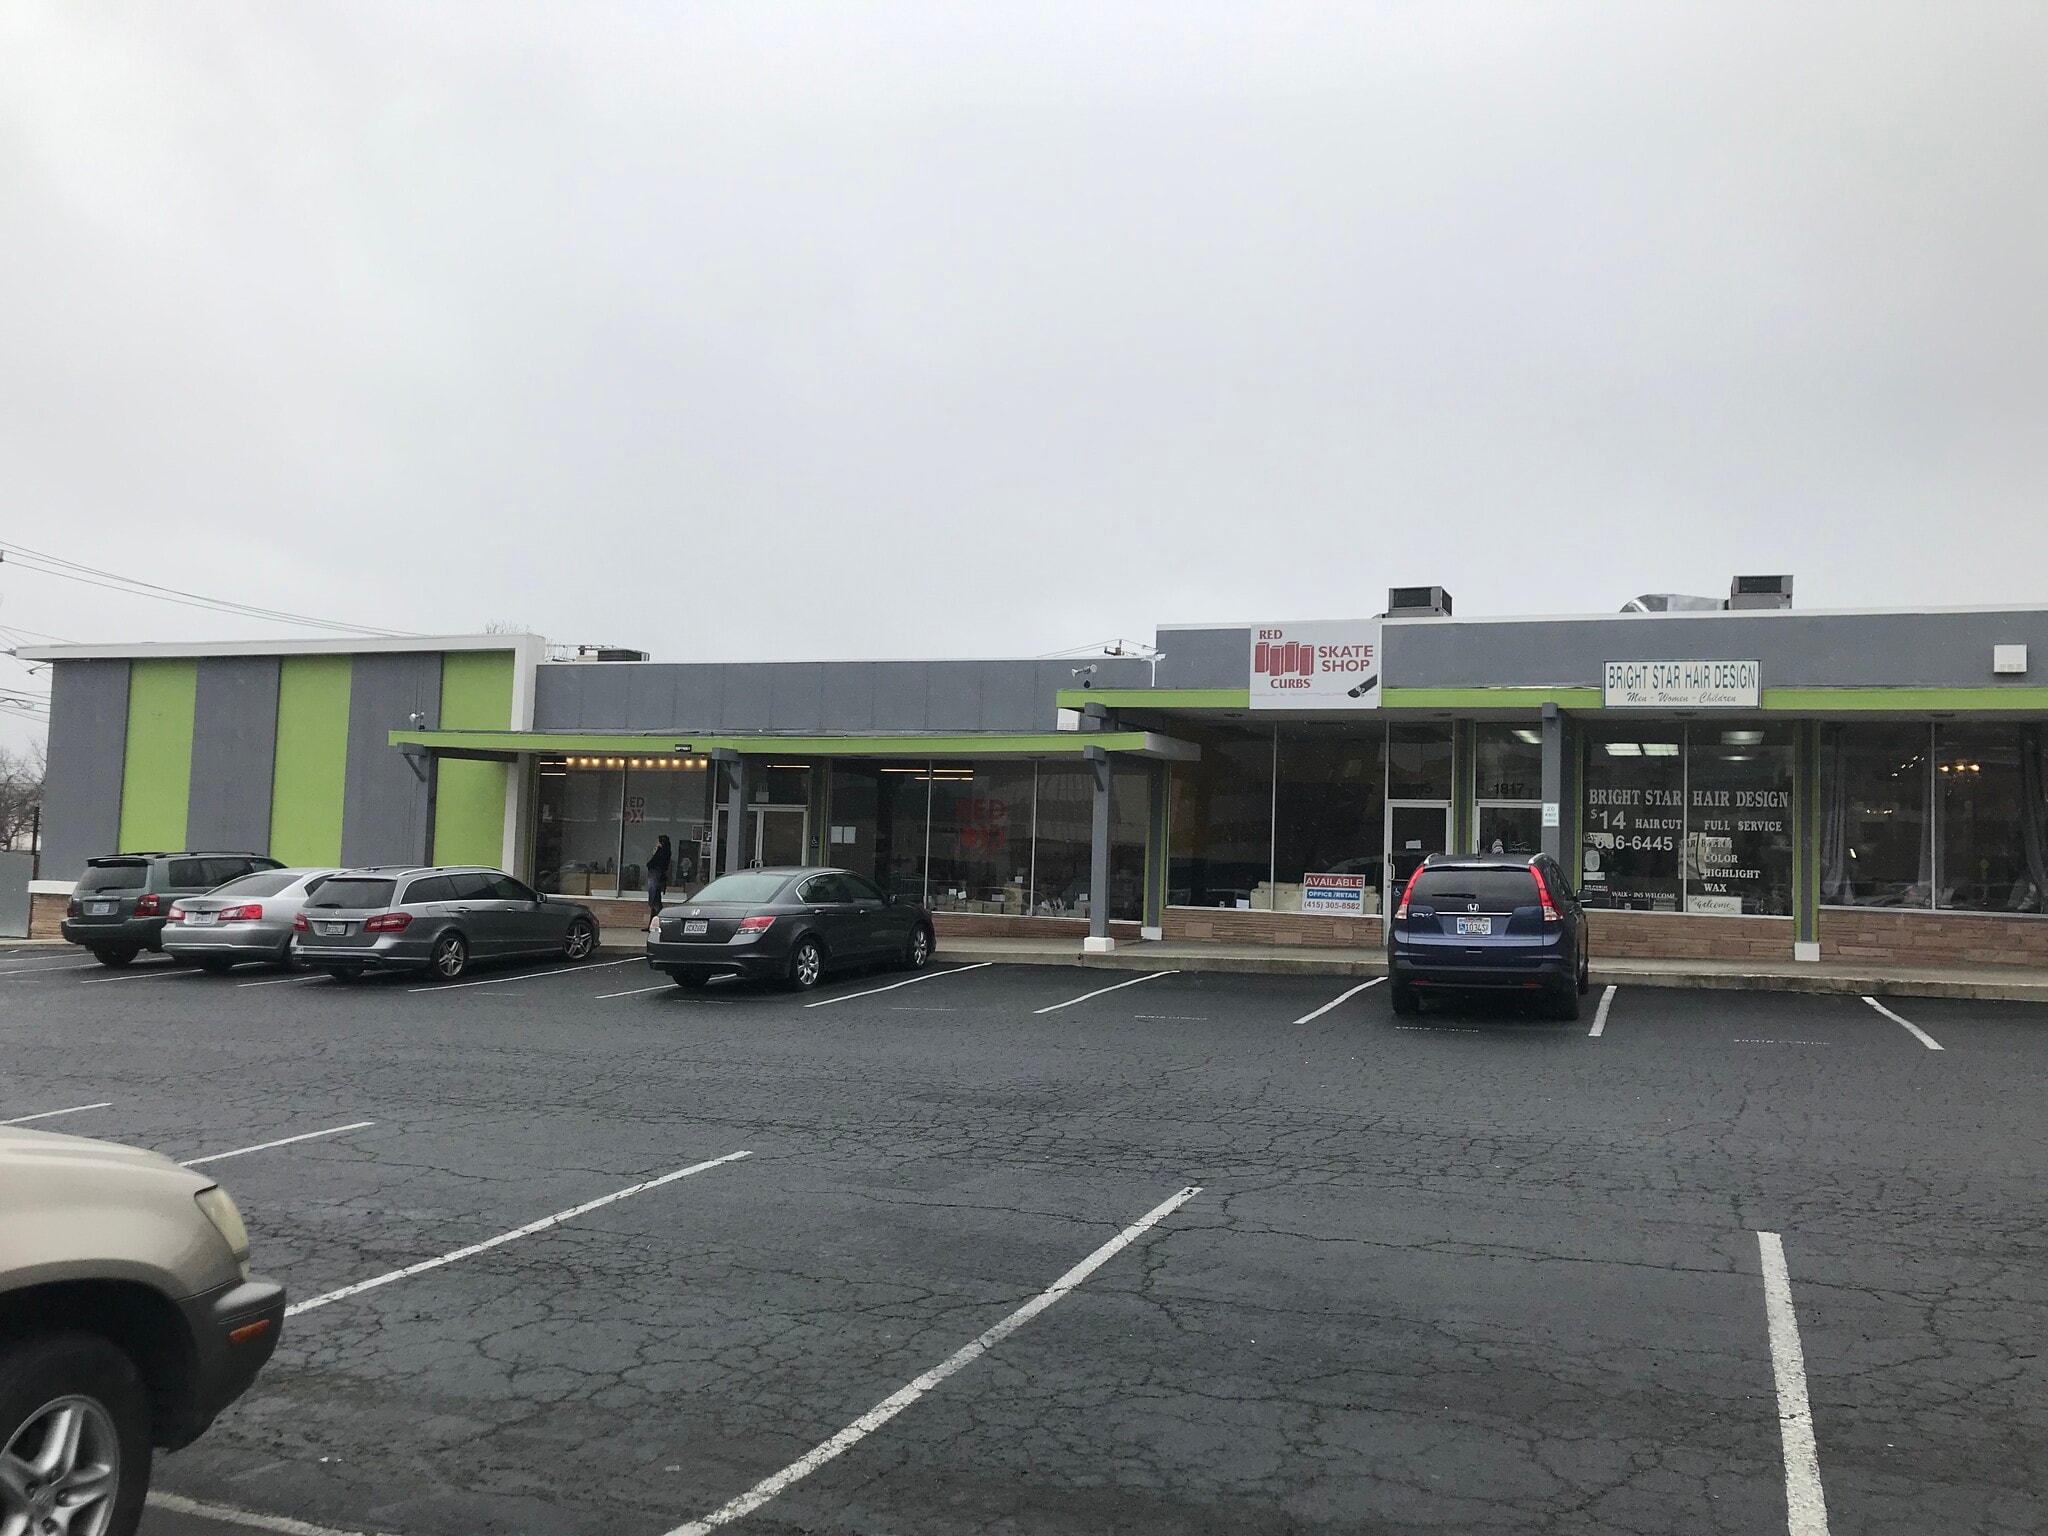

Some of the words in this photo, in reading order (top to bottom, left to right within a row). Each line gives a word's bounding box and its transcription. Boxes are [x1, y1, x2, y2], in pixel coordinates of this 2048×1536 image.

[1259, 630, 1283, 640] RED
[1318, 645, 1374, 658] SKATE
[1321, 659, 1370, 672] SHOP
[1609, 665, 1648, 689] BRIGHT
[1652, 665, 1681, 689] STAR
[1685, 665, 1711, 689] HAIR
[1714, 664, 1755, 689] DESIGN
[1270, 678, 1311, 689] CURBS
[1627, 692, 1647, 702] Men
[1658, 692, 1688, 702] Women
[1699, 691, 1737, 704] Children
[1589, 789, 1640, 805] BRIGHT
[1645, 789, 1682, 806] STAR
[1692, 790, 1730, 806] HAIR
[1735, 790, 1789, 808] DESIGN
[1704, 820, 1730, 831] FULL
[1737, 820, 1782, 832] SERVICE
[1704, 854, 1738, 863] COLOR
[1704, 869, 1760, 879] HIGHLIGHT
[1305, 877, 1362, 887] AVAILABLE
[1704, 883, 1727, 893] WAX
[1308, 890, 1332, 898] OFFICE
[1304, 901, 1323, 909] (415)
[1325, 901, 1360, 910] 305-8582
